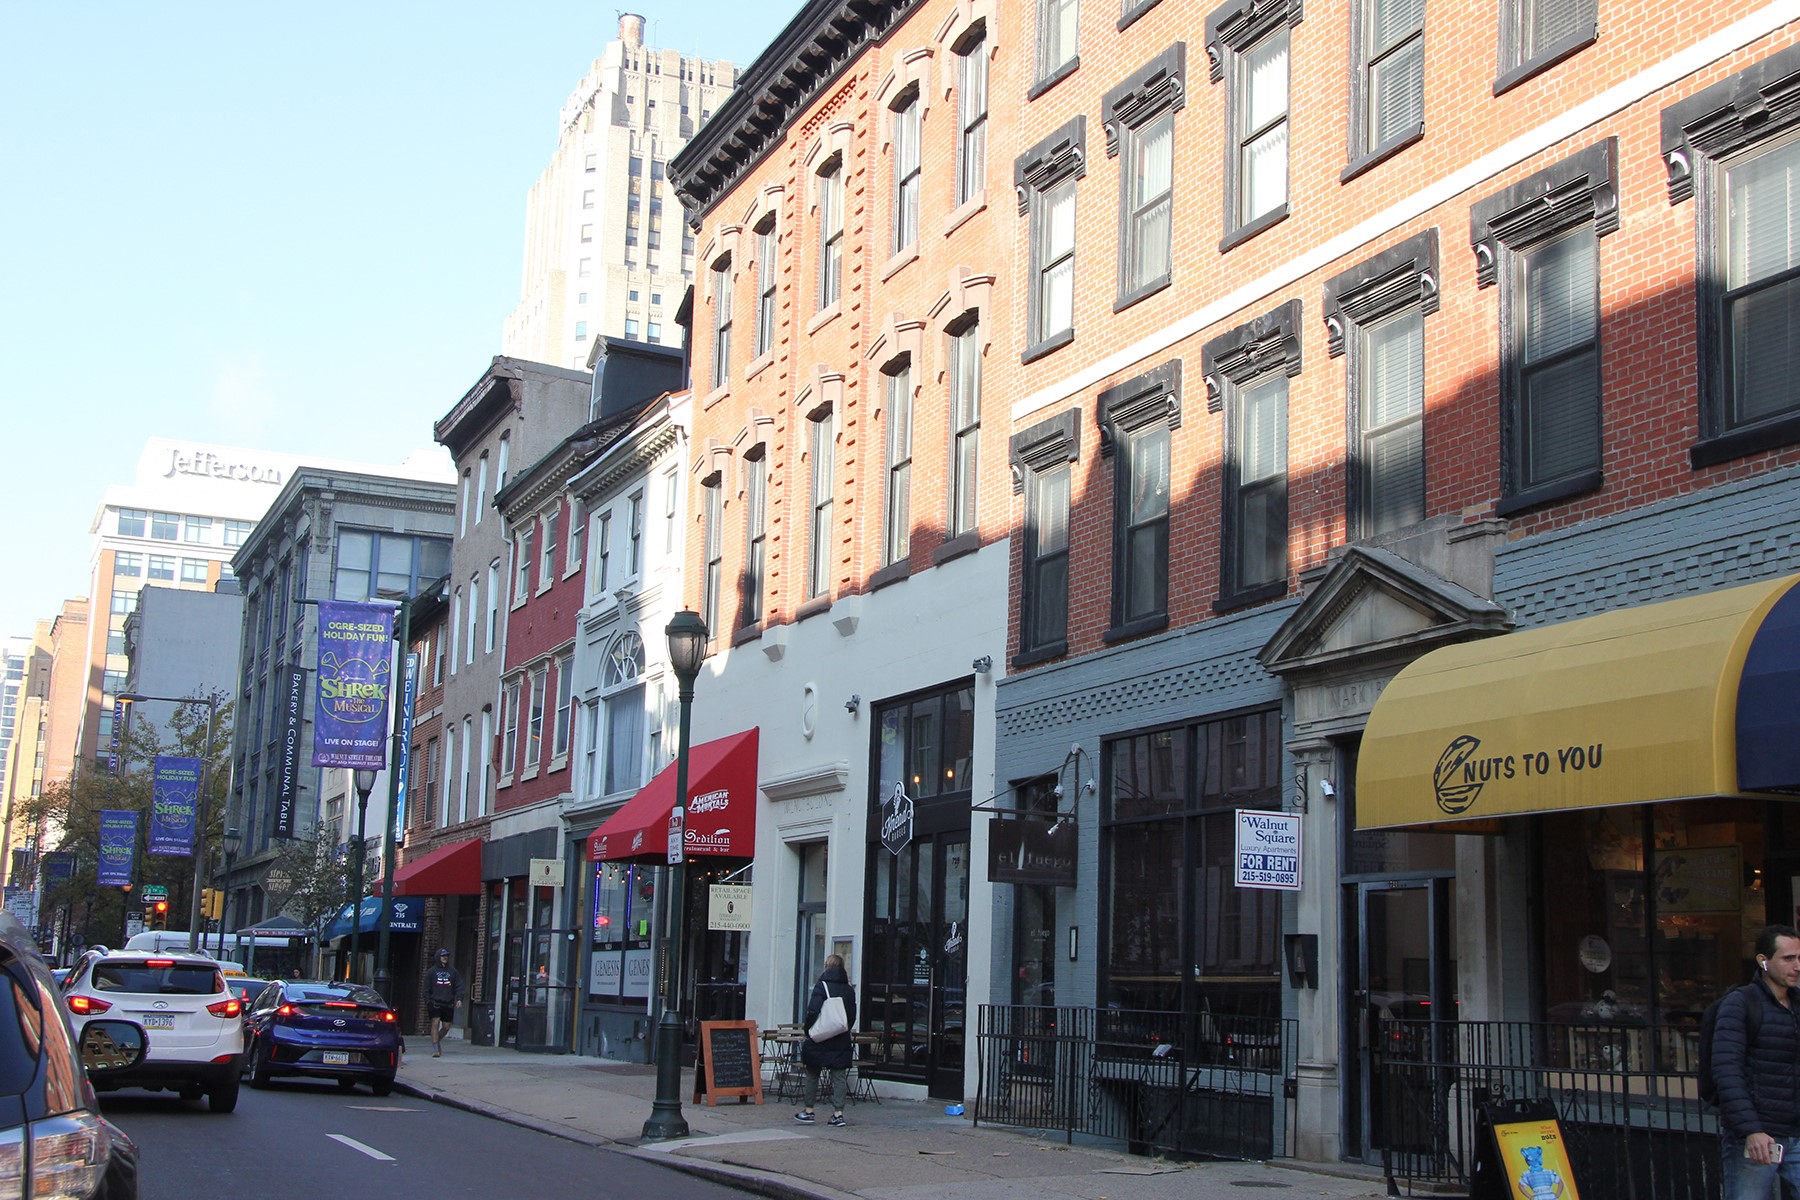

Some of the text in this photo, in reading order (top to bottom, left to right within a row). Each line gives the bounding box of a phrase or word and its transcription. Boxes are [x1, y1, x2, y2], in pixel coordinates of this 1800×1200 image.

[163, 449, 282, 485] Jefferson
[328, 621, 385, 632] OGRE-SIZED
[323, 630, 388, 642] HOLIDAY FUN!
[279, 672, 302, 832] BAKERY & COMMUNAL TABLE
[1464, 743, 1602, 783] NUTS TO YOU
[688, 791, 729, 811] AMERICAN
[696, 799, 729, 813] MORTALS
[1241, 816, 1288, 831] Walnut
[1255, 830, 1296, 844] Square
[1240, 844, 1297, 854] Luxury Apartments
[998, 851, 1015, 864] el
[1241, 854, 1297, 872] FOR RENT
[1242, 871, 1294, 883] 215-519-0895
[710, 921, 751, 929] 215-440-0900
[595, 960, 620, 977] GENESIS
